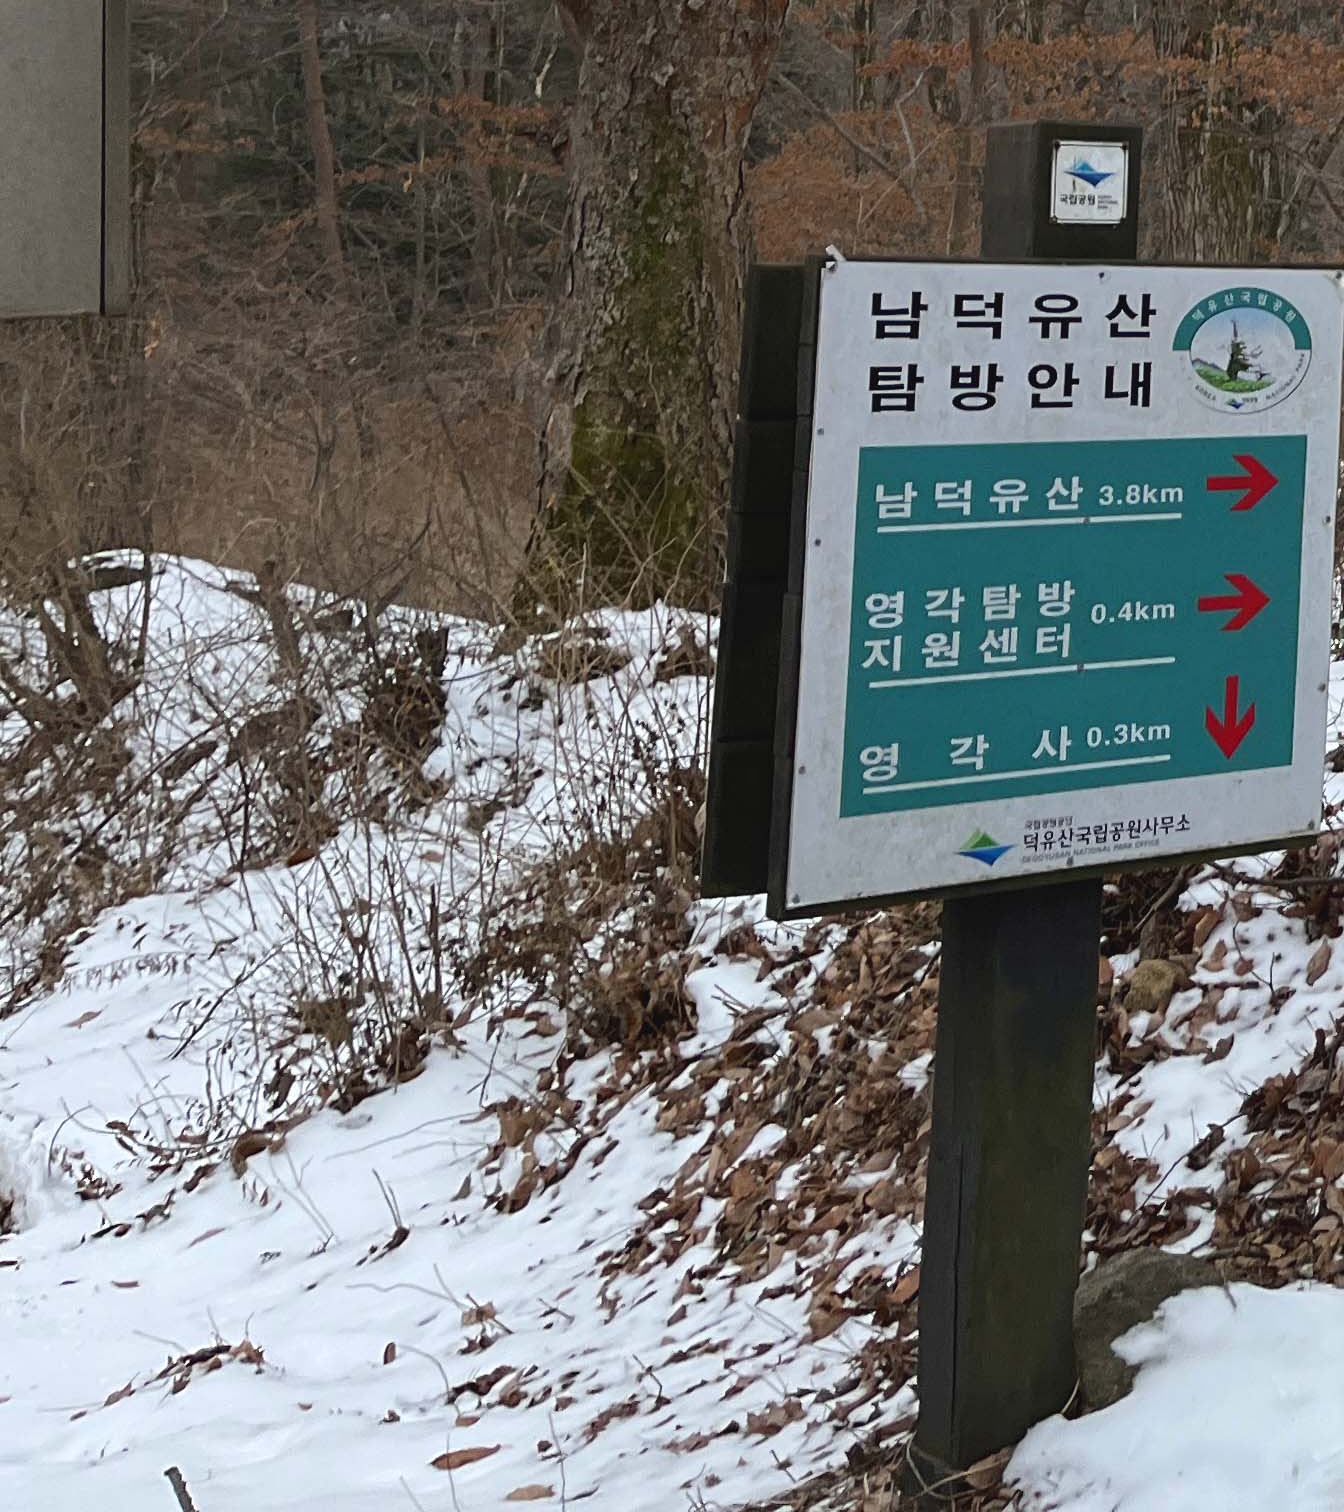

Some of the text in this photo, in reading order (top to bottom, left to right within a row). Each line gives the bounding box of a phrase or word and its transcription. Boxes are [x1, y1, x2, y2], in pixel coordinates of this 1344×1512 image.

[871, 291, 1157, 339] 남덕유산
[868, 361, 1152, 413] 탐방안내
[874, 476, 1184, 519] 남덕유산 3.8km
[864, 580, 1176, 629] 영각탐방 0.4km
[861, 622, 1072, 673] 지원센터
[1086, 722, 1171, 748] 0.3km
[1023, 813, 1191, 853] 덕유산국립공원사무소
